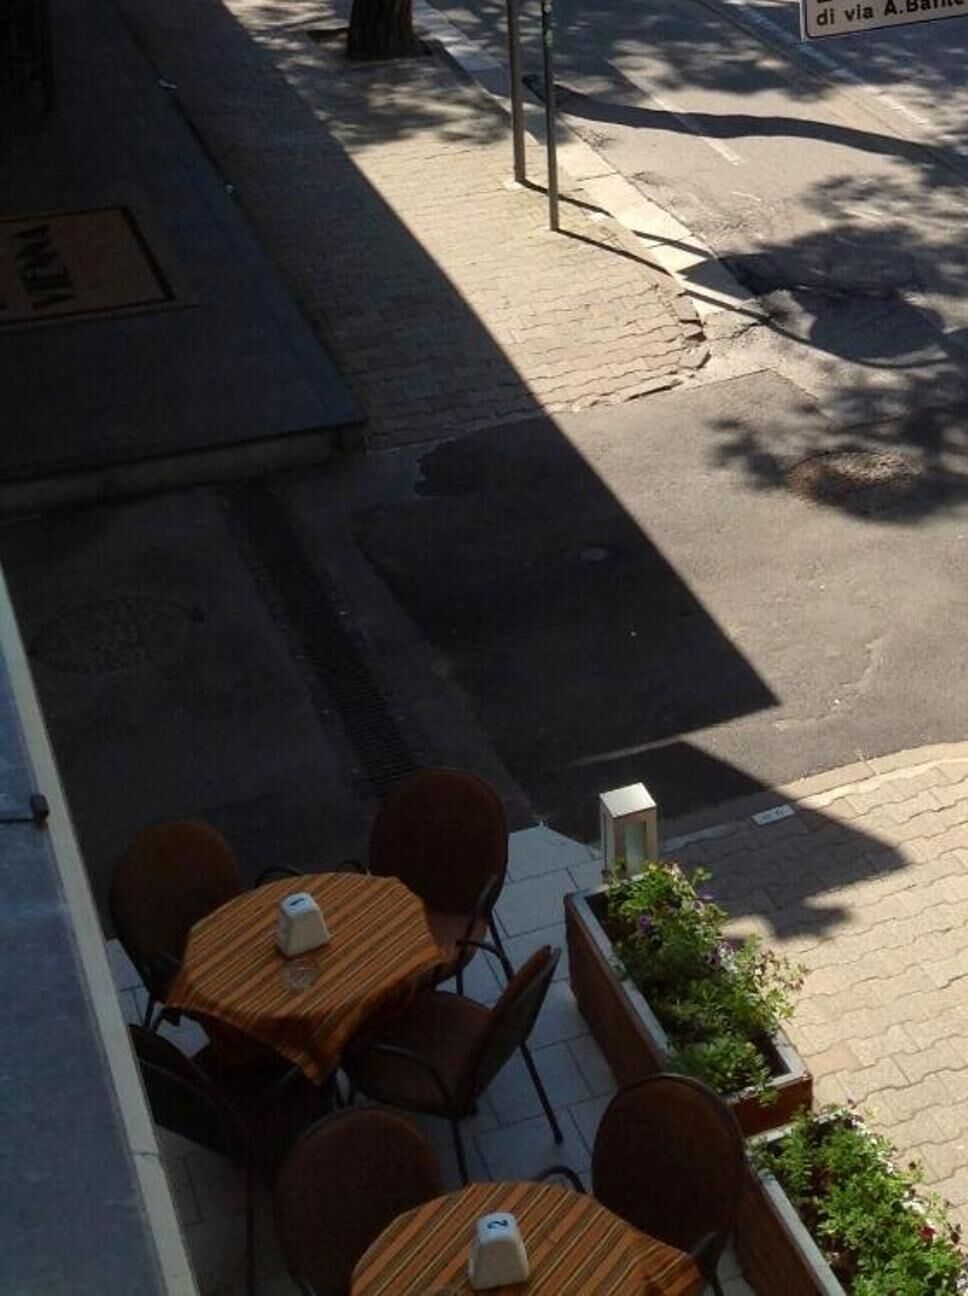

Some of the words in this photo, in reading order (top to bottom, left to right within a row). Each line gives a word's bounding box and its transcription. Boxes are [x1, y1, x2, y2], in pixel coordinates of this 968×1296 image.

[816, 8, 835, 26] di
[844, 4, 874, 21] via
[486, 1219, 508, 1229] 2
